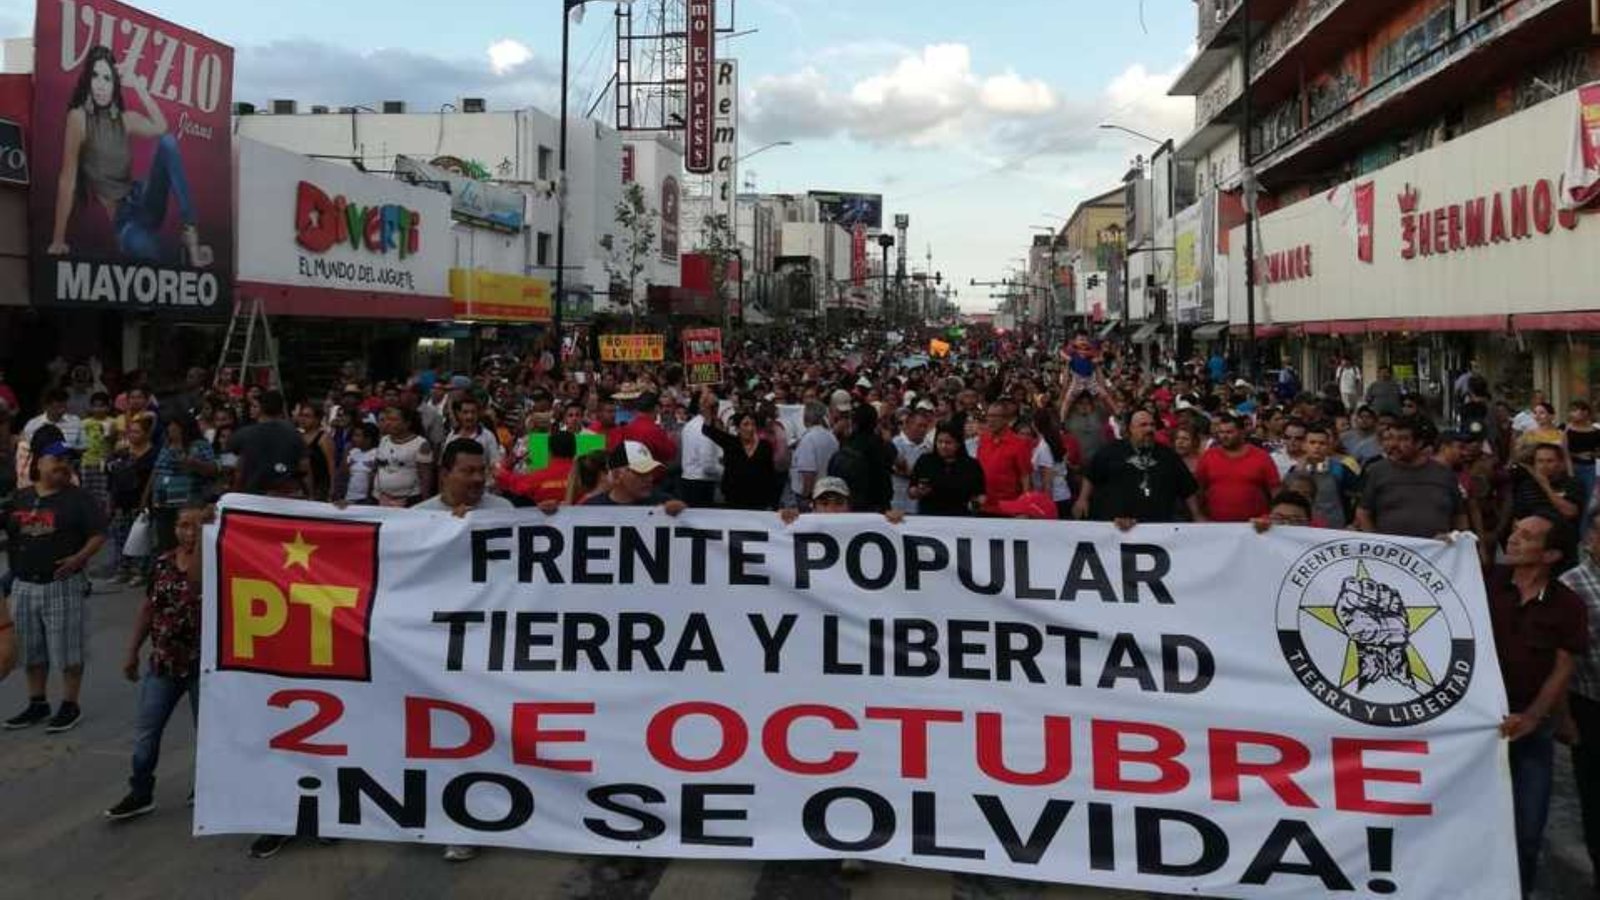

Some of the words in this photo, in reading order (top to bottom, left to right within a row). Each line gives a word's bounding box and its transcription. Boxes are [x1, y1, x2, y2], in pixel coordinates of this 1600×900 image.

[60, 0, 222, 113] VIZZIO
[692, 46, 706, 162] Express
[714, 62, 735, 231] Remate
[57, 261, 218, 307] MAYOREO
[299, 256, 312, 277] EL
[314, 258, 356, 281] MUNDO
[377, 267, 415, 290] JUGUETE
[470, 525, 770, 587] FRENTE
[793, 531, 1176, 605] POPULAR
[1291, 542, 1351, 588] FRENTE
[1360, 542, 1445, 594] POPULAR
[230, 577, 361, 666] PT
[431, 610, 725, 673] TIERRA
[747, 613, 799, 674] Y
[823, 613, 1216, 695] LIBERTAD
[1289, 651, 1356, 715] TIERRA
[1365, 705, 1378, 720] Y
[1389, 660, 1471, 723] LIBERTAD
[266, 689, 349, 756] 2
[404, 695, 596, 773] DE
[645, 700, 1433, 816] OCTUBRE
[583, 782, 756, 847] SE
[802, 786, 1399, 895] OLVIDA!
